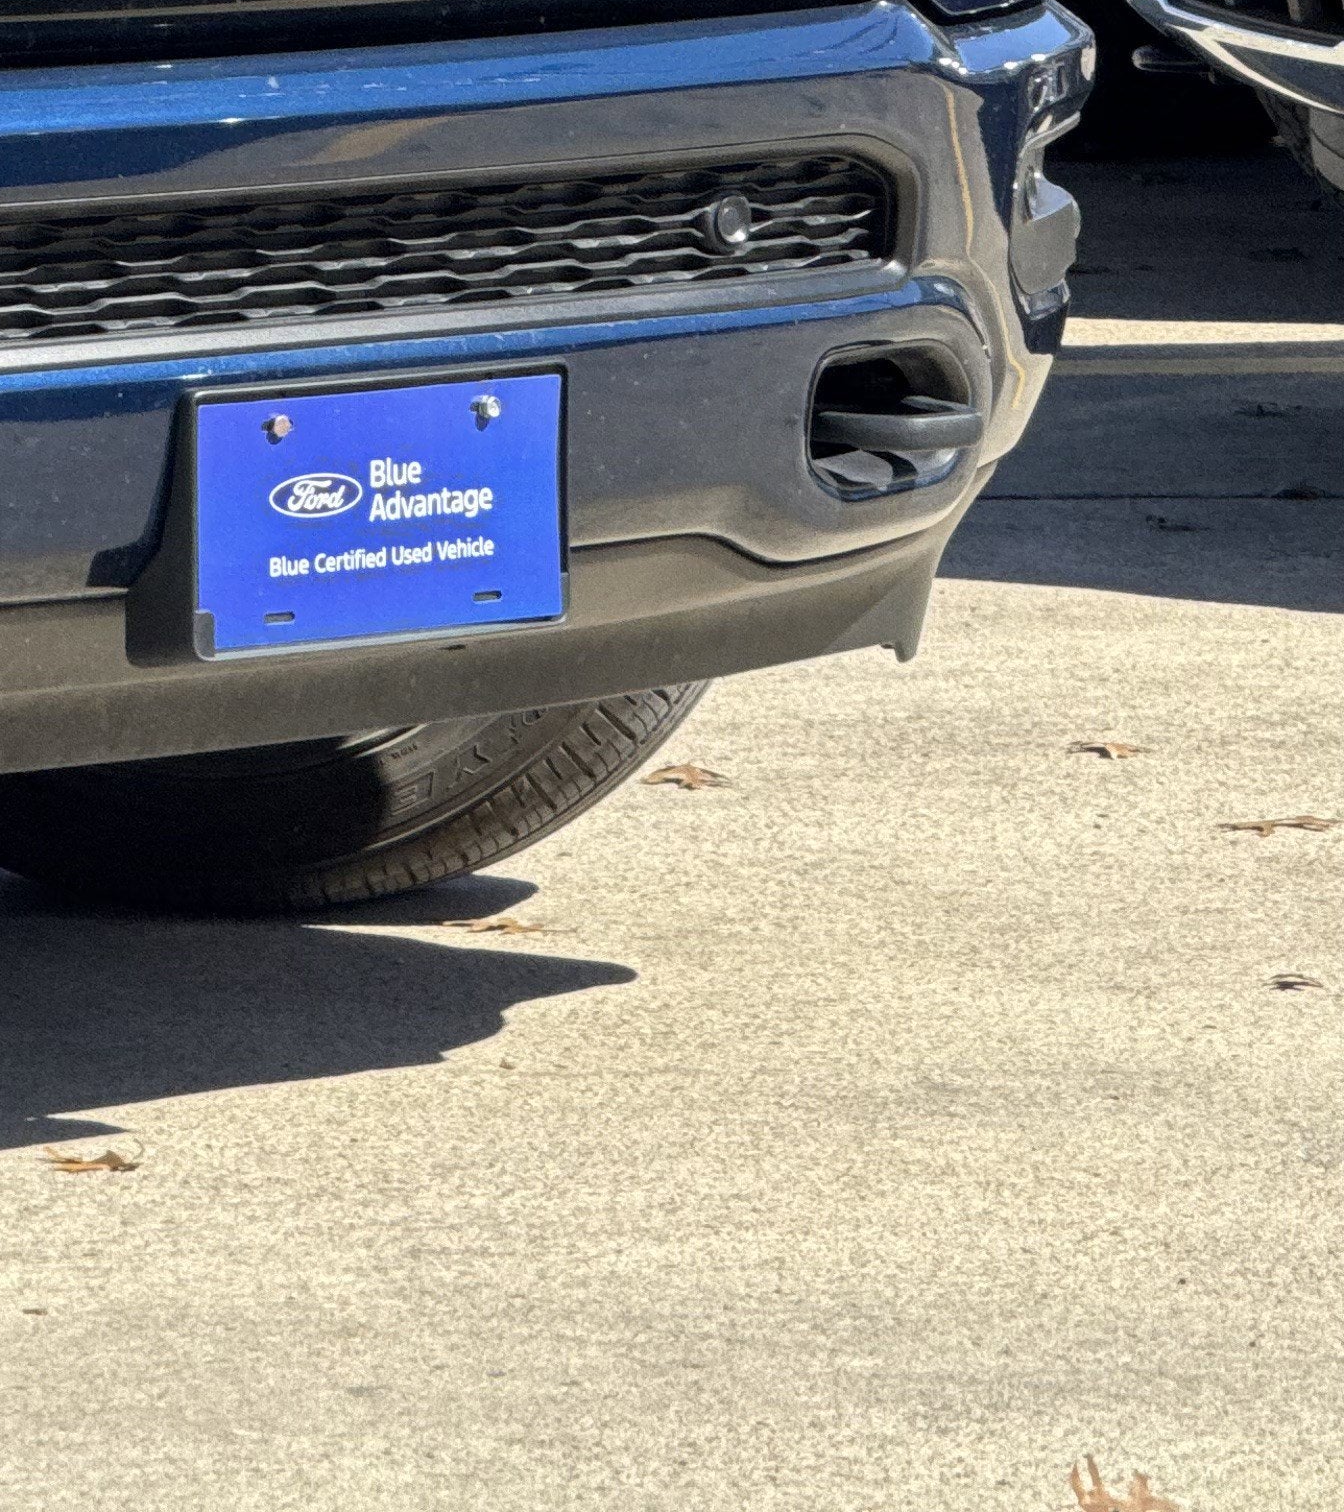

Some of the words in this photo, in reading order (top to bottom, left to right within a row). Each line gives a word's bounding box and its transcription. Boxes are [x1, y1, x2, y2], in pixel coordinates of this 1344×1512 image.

[369, 457, 422, 488] Blue
[287, 479, 346, 511] Ford
[369, 487, 493, 522] Advantage
[269, 555, 310, 578] Blue
[314, 546, 387, 574] Certified
[391, 541, 433, 566] Used
[436, 535, 496, 561] Vehicle
